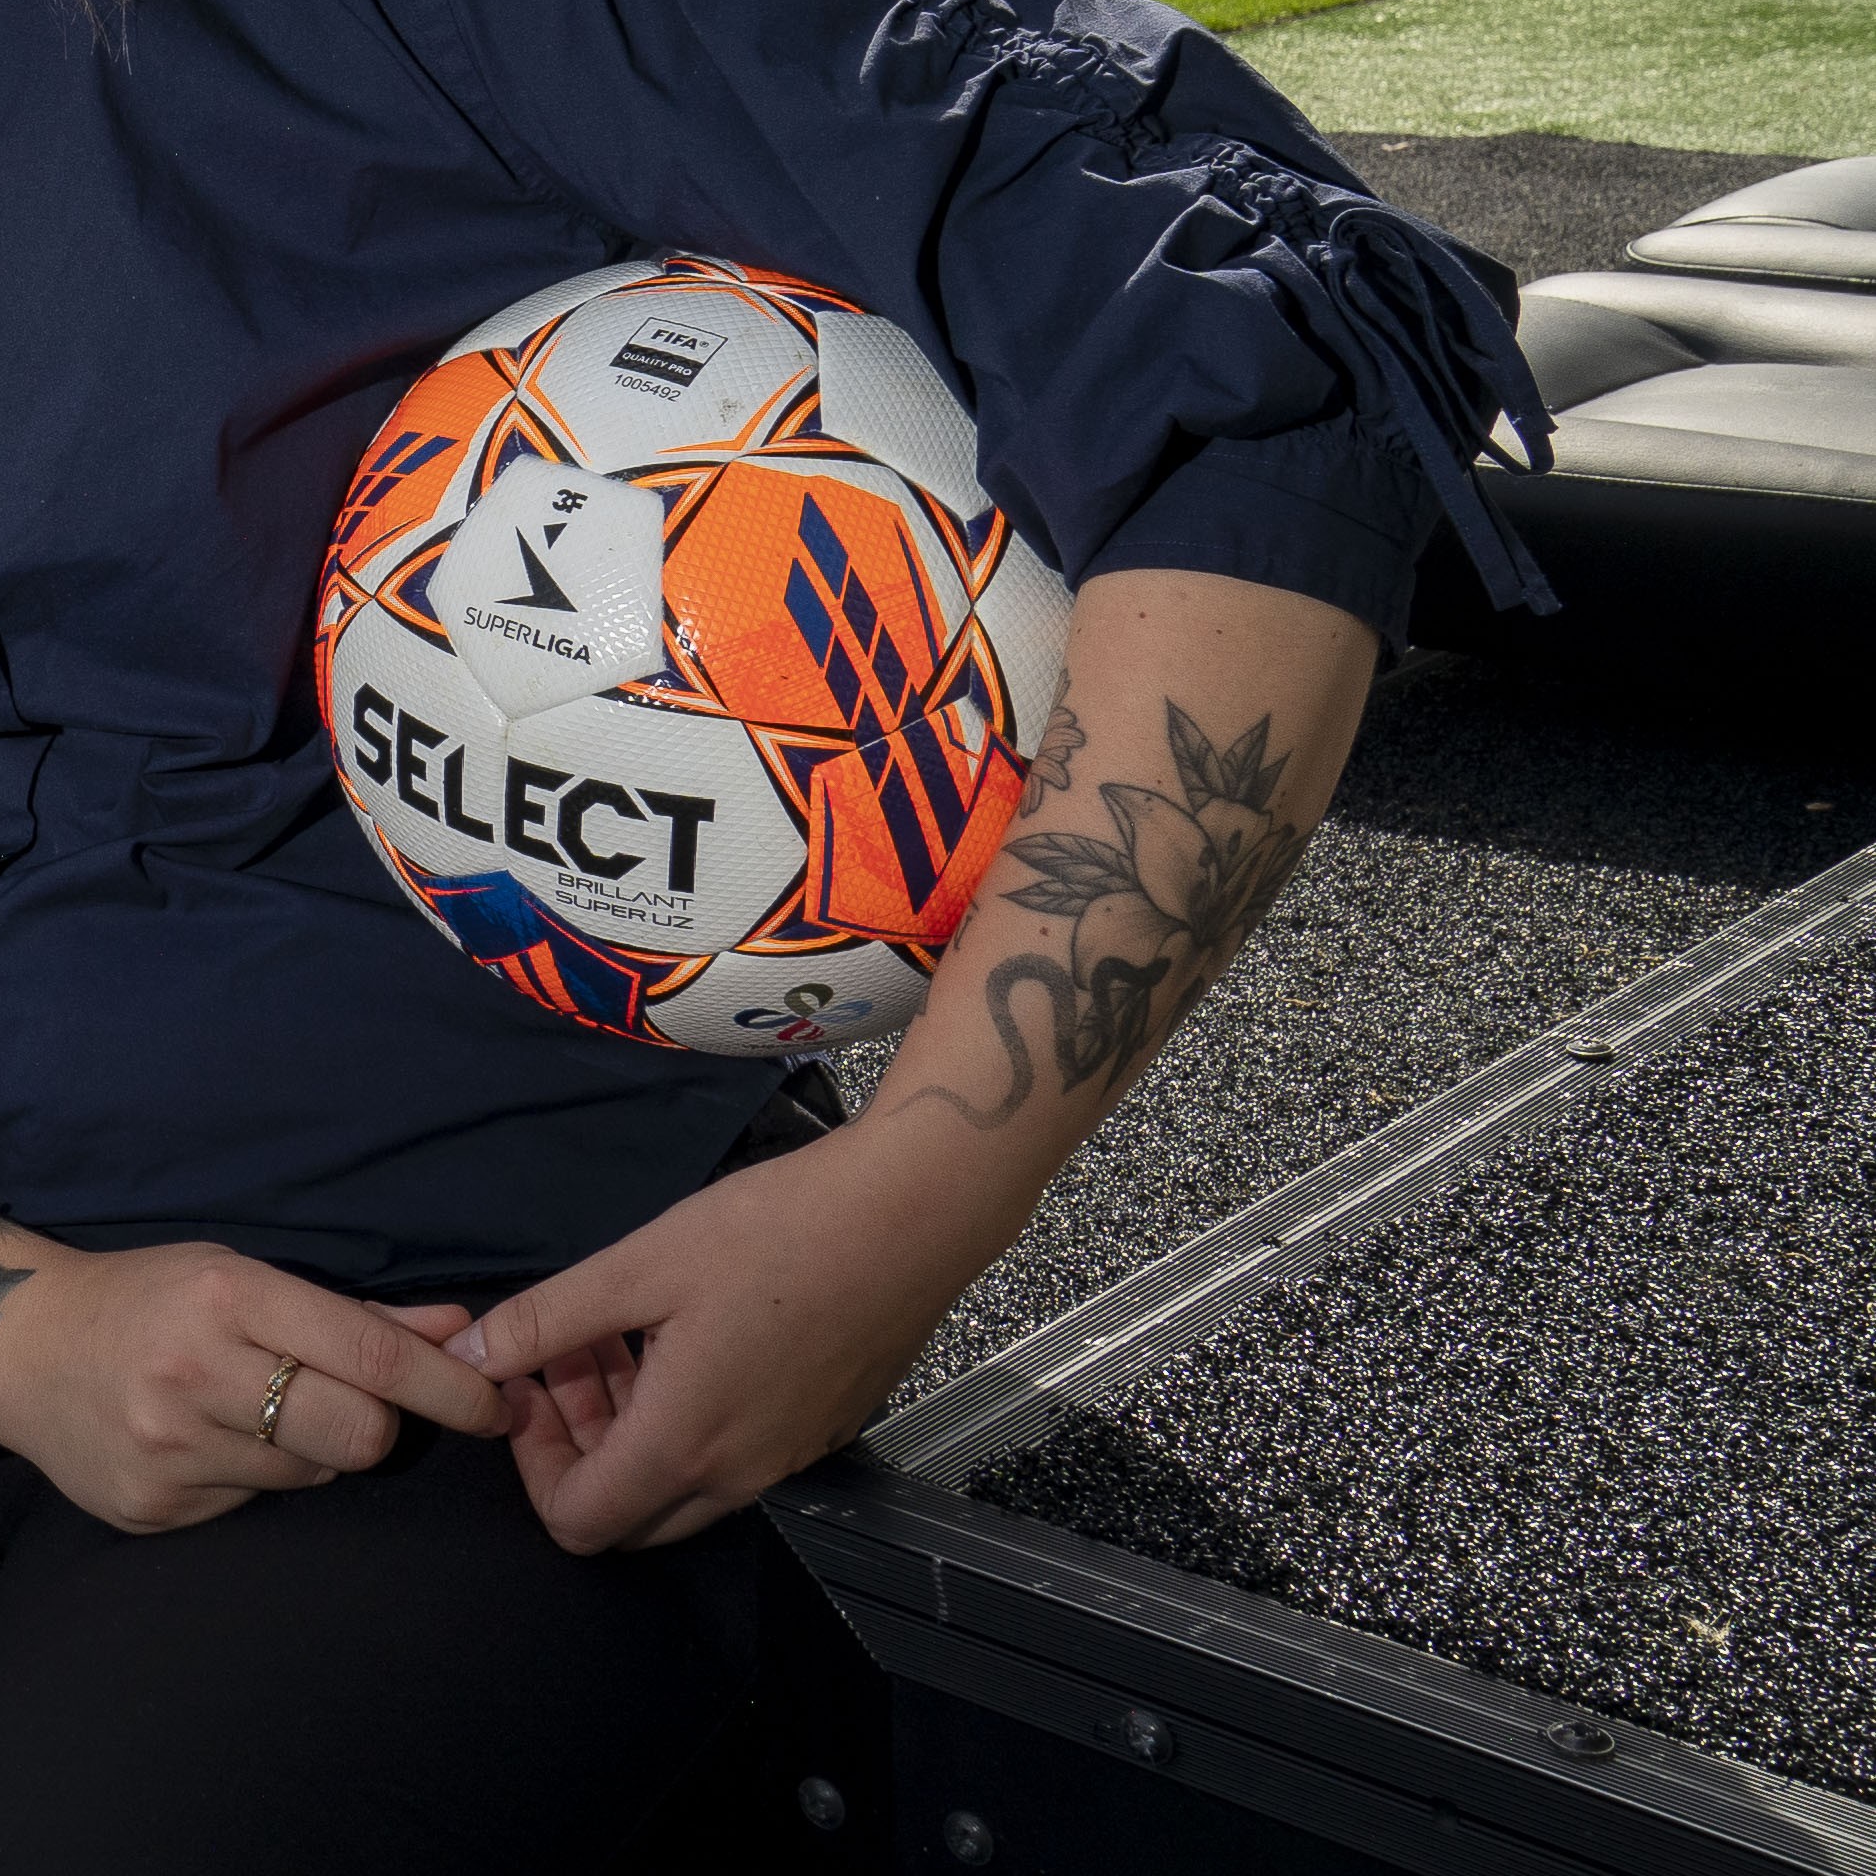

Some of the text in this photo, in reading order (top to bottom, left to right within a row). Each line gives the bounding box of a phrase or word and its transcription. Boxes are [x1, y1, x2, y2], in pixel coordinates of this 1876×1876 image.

[622, 352, 693, 376] QUALITY PRO
[614, 373, 682, 402] 1005492
[551, 488, 589, 514] 3F
[463, 605, 592, 666] SUPERLIGA
[353, 681, 717, 894] SELECT
[555, 889, 695, 930] SUPER UZ
[557, 871, 695, 912] BRILLANT
